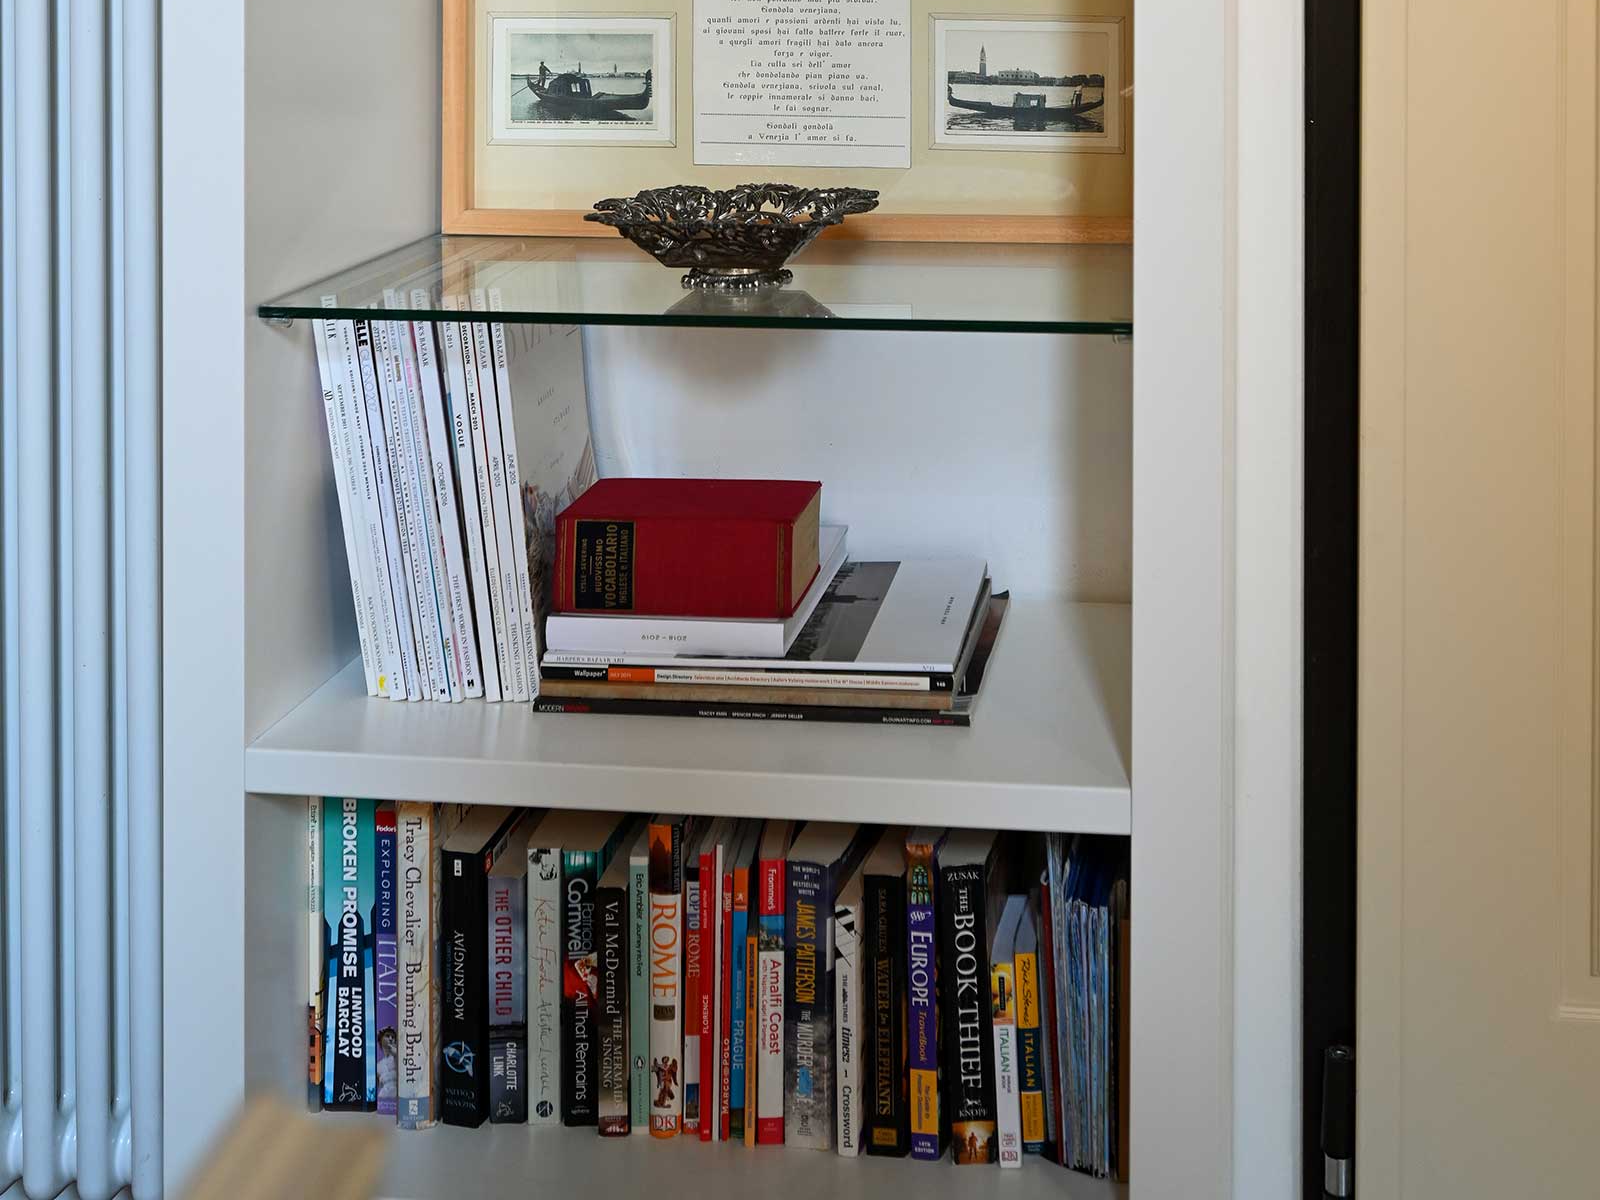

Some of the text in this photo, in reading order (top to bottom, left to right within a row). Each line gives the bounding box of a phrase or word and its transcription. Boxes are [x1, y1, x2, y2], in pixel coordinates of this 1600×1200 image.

[356, 319, 368, 347] ELLE
[478, 340, 488, 370] BAZAAR
[495, 339, 505, 369] BAZAAR
[461, 324, 471, 365] DECORATION
[469, 392, 478, 415] MARCH
[455, 414, 466, 449] VOGUE
[594, 538, 604, 593] NUOVISSIMO
[604, 523, 618, 608] VOCABOLARIO
[619, 527, 629, 564] ITALIANO
[462, 646, 473, 676] FASHION
[510, 623, 520, 661] THINKING
[523, 622, 534, 660] THINKING
[514, 661, 524, 695] FASHION
[527, 661, 538, 695] FASHION
[538, 704, 565, 712] MODERN
[403, 817, 422, 862] Tracy
[342, 798, 358, 978] BROKEN PROMISE
[635, 873, 644, 888] Eric
[946, 871, 980, 883] ZUSAK
[378, 838, 397, 1008] EXPLORING ITALY
[405, 867, 422, 946] Chevalier
[567, 878, 589, 960] Cornwell
[582, 903, 595, 951] Patricia
[635, 889, 645, 919] Ambler
[494, 888, 512, 1016] THE OTHER CHILD
[652, 901, 678, 998] ROME
[687, 886, 700, 978] TOP 10 ROME
[795, 900, 816, 1004] JAMES PATTERSON
[453, 929, 468, 1021] MOCKINGJAY
[604, 901, 620, 1015] Val McDermid
[910, 929, 933, 1007] EUROPE
[403, 961, 422, 1029] Burning
[575, 990, 589, 1007] All
[768, 959, 782, 1055] Amalfi Coast
[877, 959, 890, 1010] WATER
[953, 886, 983, 1089] THE BOOK THIEF
[338, 986, 350, 1058] BARCLAY
[350, 986, 363, 1059] LINWOOD
[575, 1008, 589, 1039] That
[702, 993, 710, 1034] FLORENCE
[800, 1009, 812, 1021] THE
[918, 1011, 928, 1062] TravelBook
[403, 1031, 422, 1084] Bright
[493, 1055, 504, 1077] LINK
[506, 1041, 518, 1090] CHARLOTTE
[602, 1037, 613, 1088] SINGING
[612, 1016, 623, 1108] THE MERMAIDS
[732, 1019, 745, 1071] PRAGUE
[796, 1022, 814, 1067] MURDER
[999, 1028, 1011, 1073] ITALIAN
[1023, 1031, 1036, 1088] ITALIAN
[575, 1042, 589, 1101] Remains
[722, 1037, 731, 1115] MARCO POLO
[877, 1026, 891, 1116] ELEPHANTS
[653, 1115, 677, 1130] DK
[842, 1086, 853, 1148] Crossword
